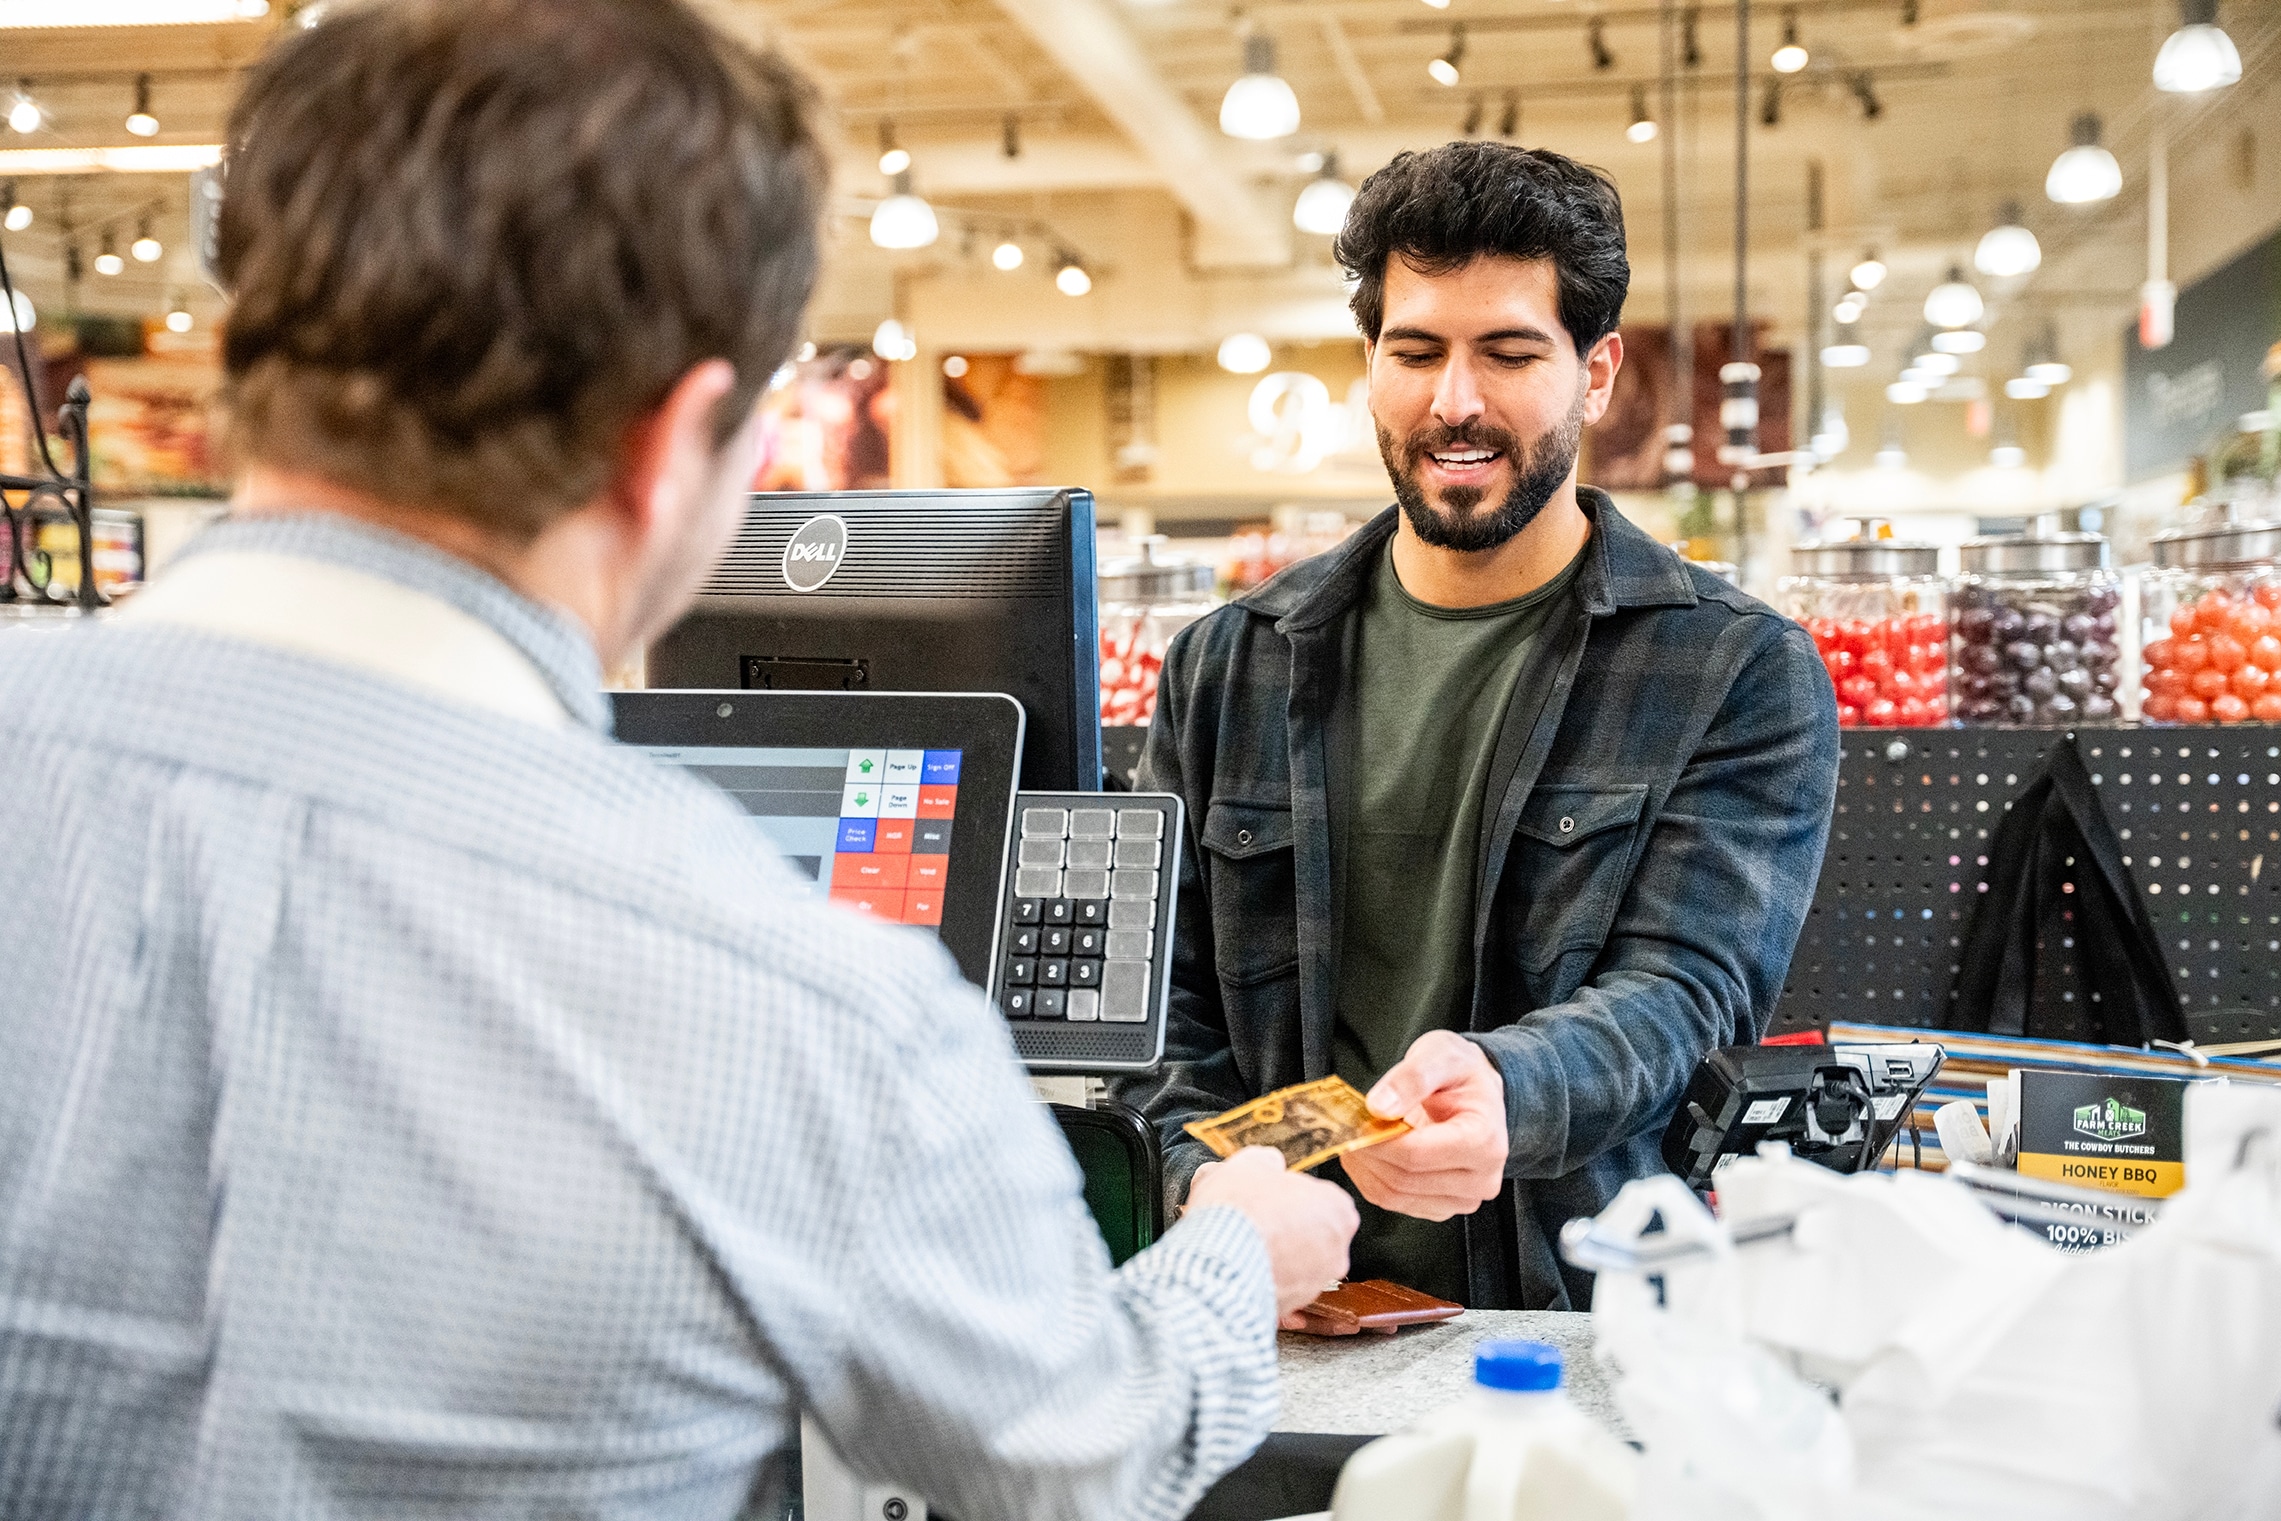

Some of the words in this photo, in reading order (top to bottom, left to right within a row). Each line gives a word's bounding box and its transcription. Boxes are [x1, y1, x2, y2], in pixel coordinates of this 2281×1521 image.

[790, 542, 836, 562] DELL
[889, 763, 905, 771] Page
[907, 763, 917, 771] Up
[927, 763, 942, 771] Sign
[935, 798, 950, 806] Sale
[860, 866, 880, 874] Clear
[1022, 903, 1032, 917] 7
[1054, 904, 1064, 917] 8
[1085, 904, 1096, 918] 9
[1018, 934, 1028, 947] 4
[1051, 932, 1061, 946] 5
[1082, 935, 1093, 948] 6
[1015, 964, 1024, 977] 1
[1048, 964, 1058, 978] 2
[1080, 965, 1090, 979] 3
[1011, 995, 1023, 1008] 0
[2077, 1119, 2105, 1130] FARM
[2108, 1120, 2143, 1132] CREEK
[2097, 1129, 2121, 1137] MEATS
[2064, 1141, 2079, 1150] THE
[2080, 1142, 2113, 1152] COWBOY
[2114, 1144, 2155, 1155] BUTCHERS
[2062, 1163, 2119, 1180] HONEY
[2123, 1168, 2157, 1184] BBQ
[2047, 1224, 2098, 1244] 100%
[2103, 1228, 2130, 1245] BIS
